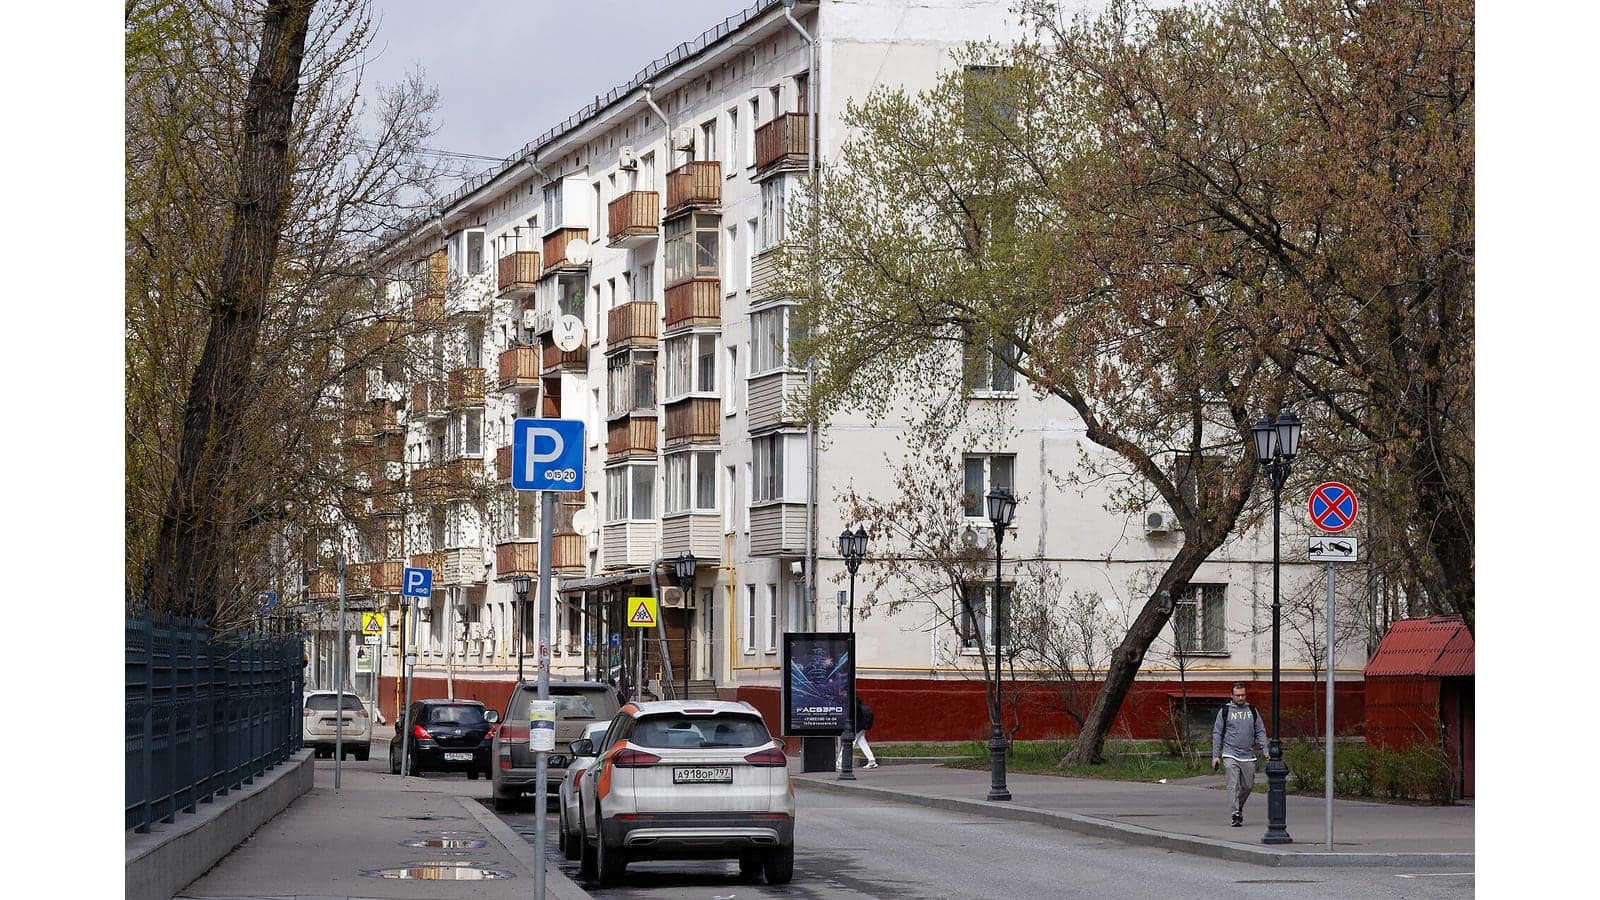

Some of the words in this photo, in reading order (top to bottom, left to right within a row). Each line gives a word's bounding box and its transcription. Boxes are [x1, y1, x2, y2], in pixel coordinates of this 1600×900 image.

[525, 427, 564, 481] P
[554, 471, 562, 479] 15
[563, 471, 576, 480] 20
[408, 570, 424, 593] P
